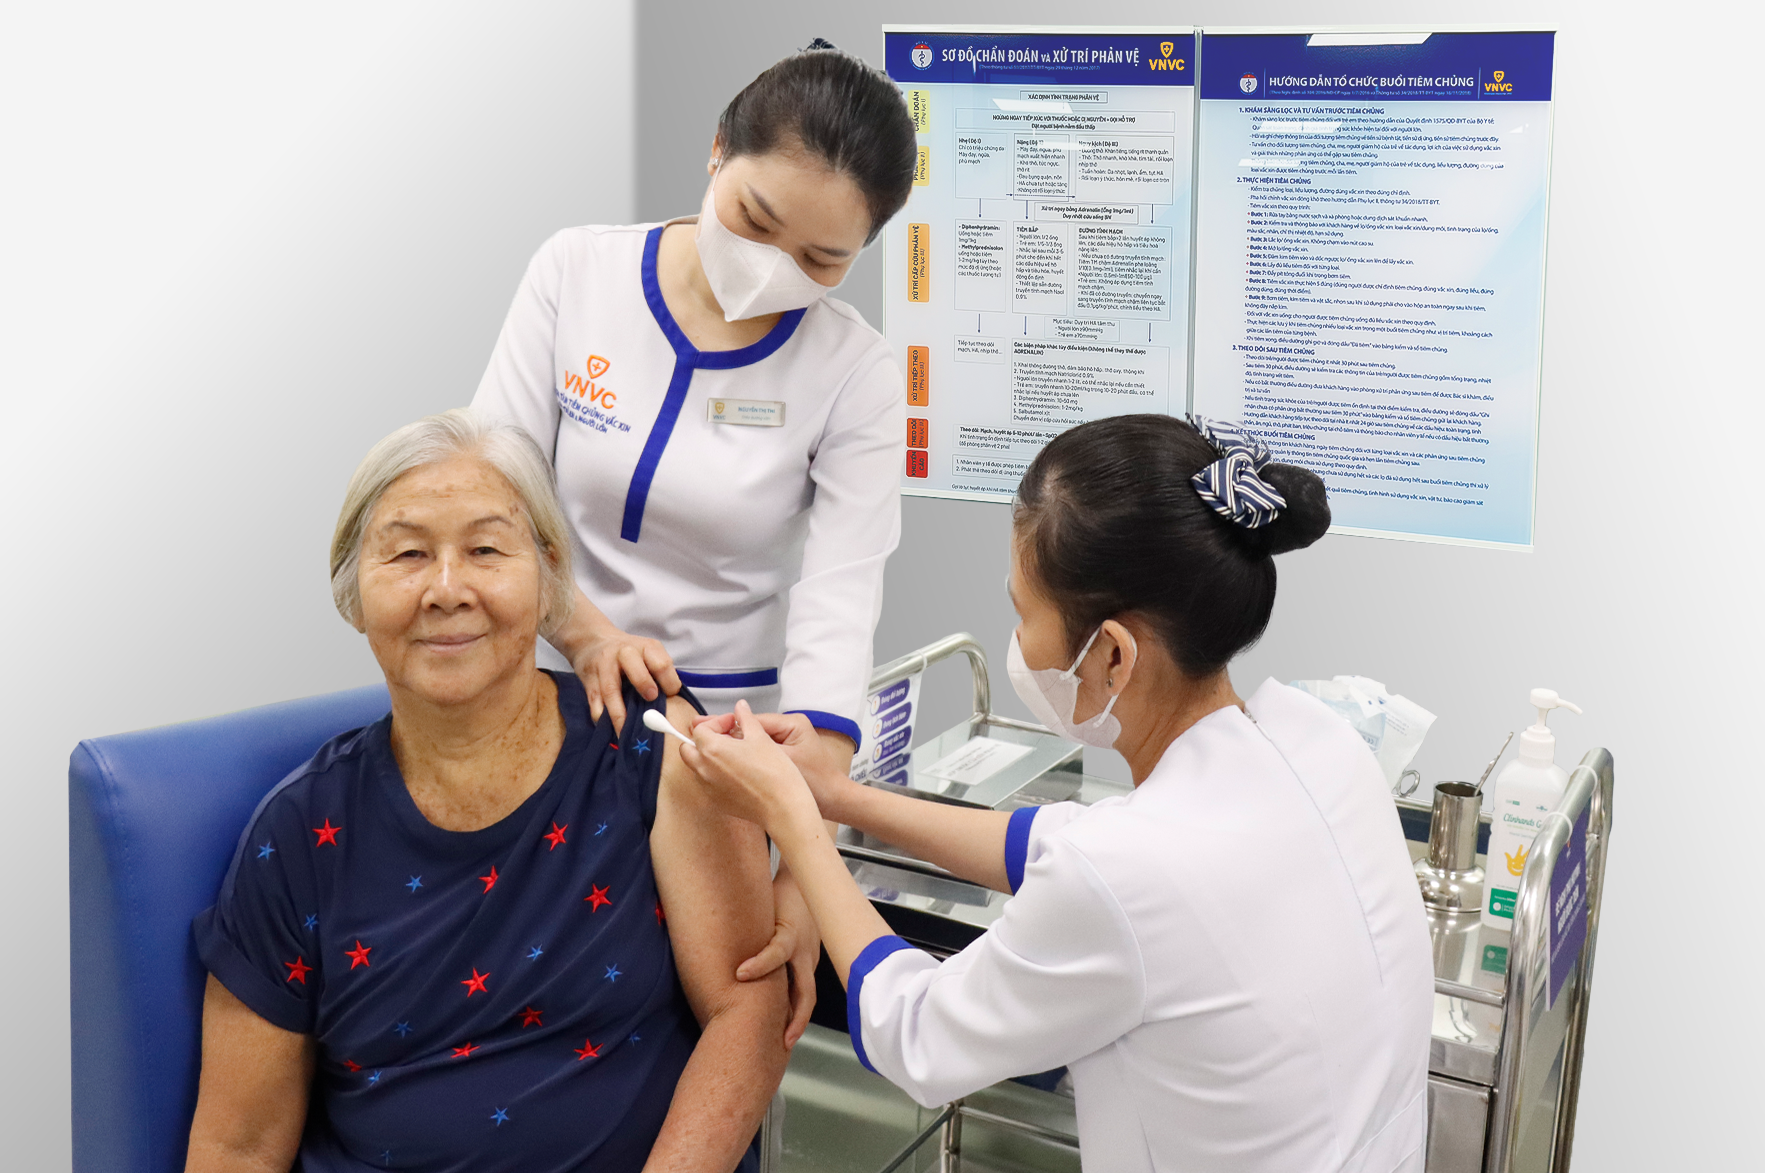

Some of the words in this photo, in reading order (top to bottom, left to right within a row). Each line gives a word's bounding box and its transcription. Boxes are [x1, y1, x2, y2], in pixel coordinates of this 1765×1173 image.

[942, 48, 956, 61] SƠ
[976, 46, 1004, 62] CHẨN
[1008, 48, 1038, 62] ĐOÁN
[1052, 46, 1067, 62] XỬ
[1070, 48, 1088, 62] TRÍ
[1091, 48, 1122, 62] PHẢN
[1125, 47, 1139, 66] VỆ
[1149, 58, 1184, 71] VNVC
[1269, 75, 1306, 86] HƯỚNG
[1309, 74, 1331, 86] DẪN
[1333, 74, 1346, 86] TỔ
[1348, 75, 1377, 86] CHỨC
[1380, 74, 1405, 86] BUỔI
[1408, 76, 1432, 86] TIÊM
[1434, 74, 1473, 86] CHỦNG
[1485, 83, 1512, 91] VNVC
[1362, 106, 1384, 114] CHỦNG
[563, 370, 617, 409] VNVC
[1278, 347, 1292, 437] TIÊM
